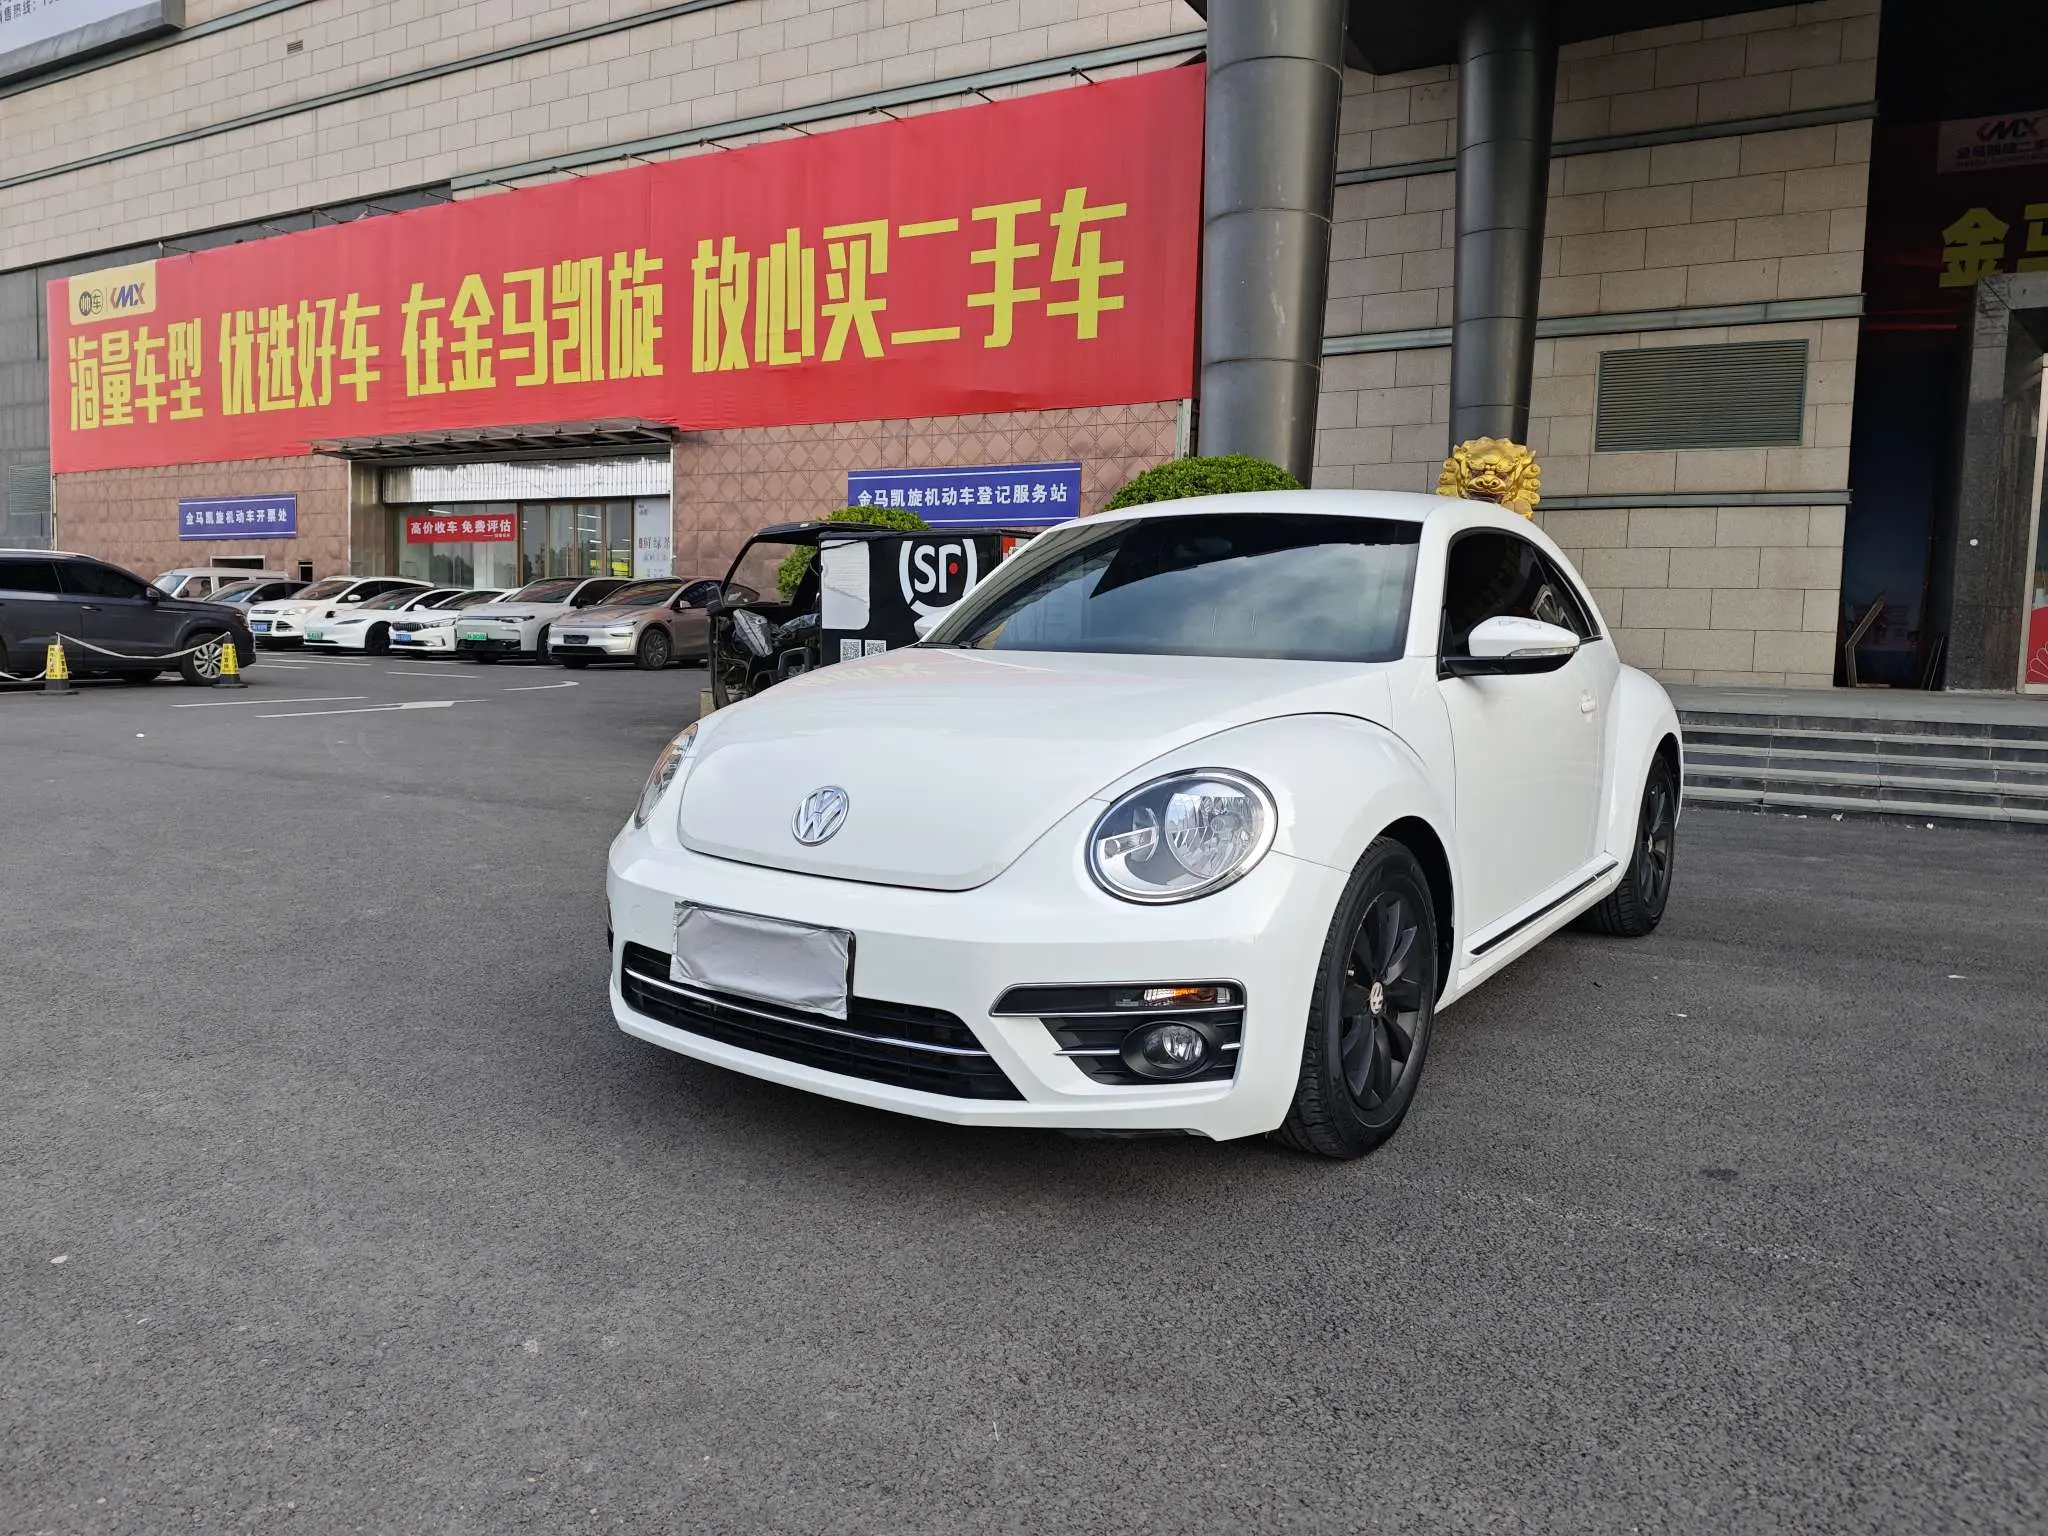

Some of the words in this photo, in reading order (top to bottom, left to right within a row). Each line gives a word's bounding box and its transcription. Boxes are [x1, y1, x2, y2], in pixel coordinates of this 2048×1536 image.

[69, 319, 203, 431] 海量车型
[219, 292, 380, 416] 优选好车
[401, 248, 664, 397] 在金马凯旋
[690, 186, 1127, 373] 放心买二手车
[857, 482, 1067, 508] 金马凯旋机动车登记服务站
[185, 508, 287, 525] 金马凯旋机动车开票处
[410, 521, 458, 535] 高价收车
[461, 519, 511, 534] 免费评估
